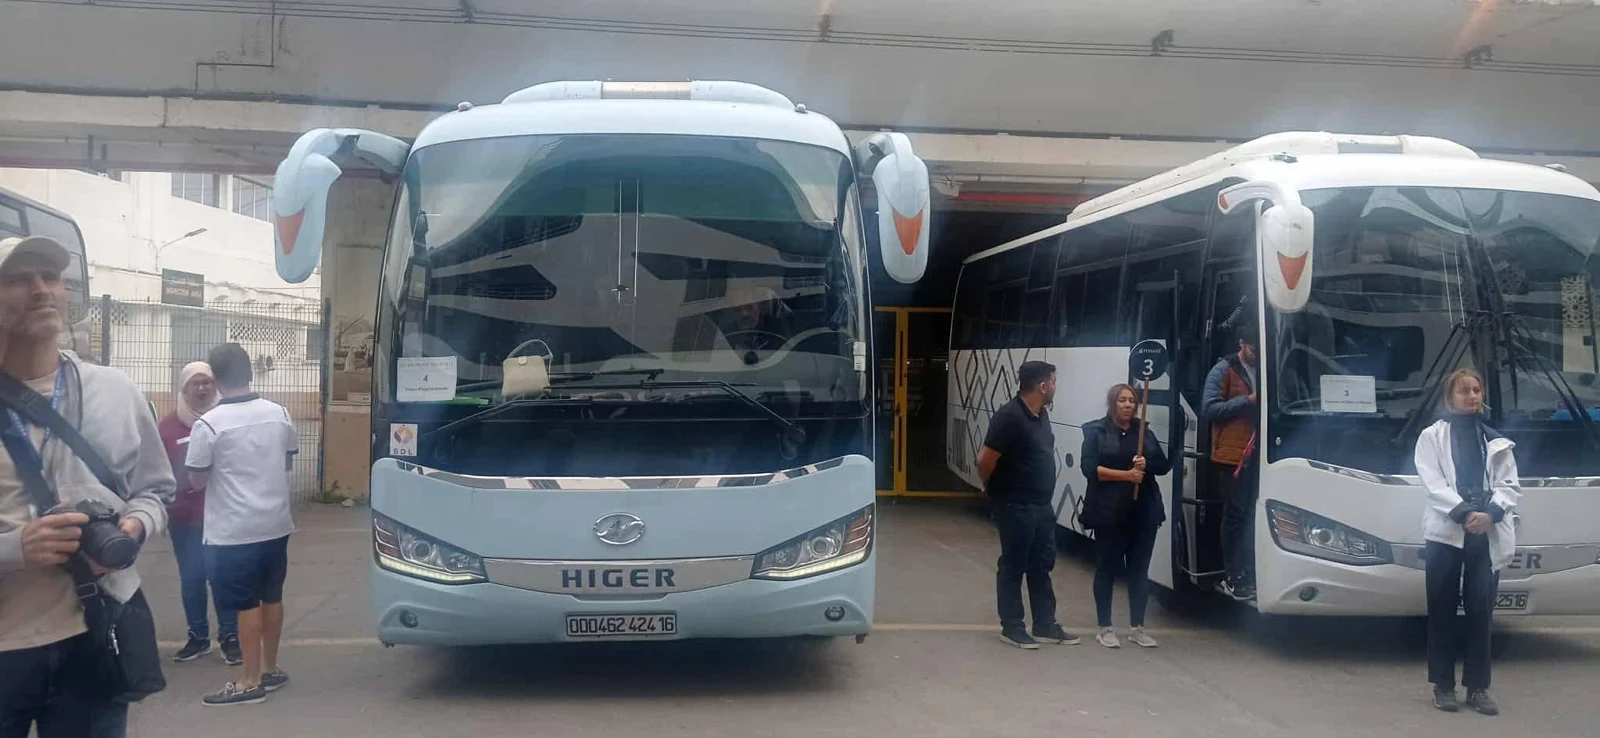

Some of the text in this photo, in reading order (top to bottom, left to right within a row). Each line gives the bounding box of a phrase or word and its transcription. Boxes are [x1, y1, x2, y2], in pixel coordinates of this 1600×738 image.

[1142, 358, 1154, 376] 3
[562, 568, 676, 588] HIGER
[569, 616, 675, 634] 000462 424 16
